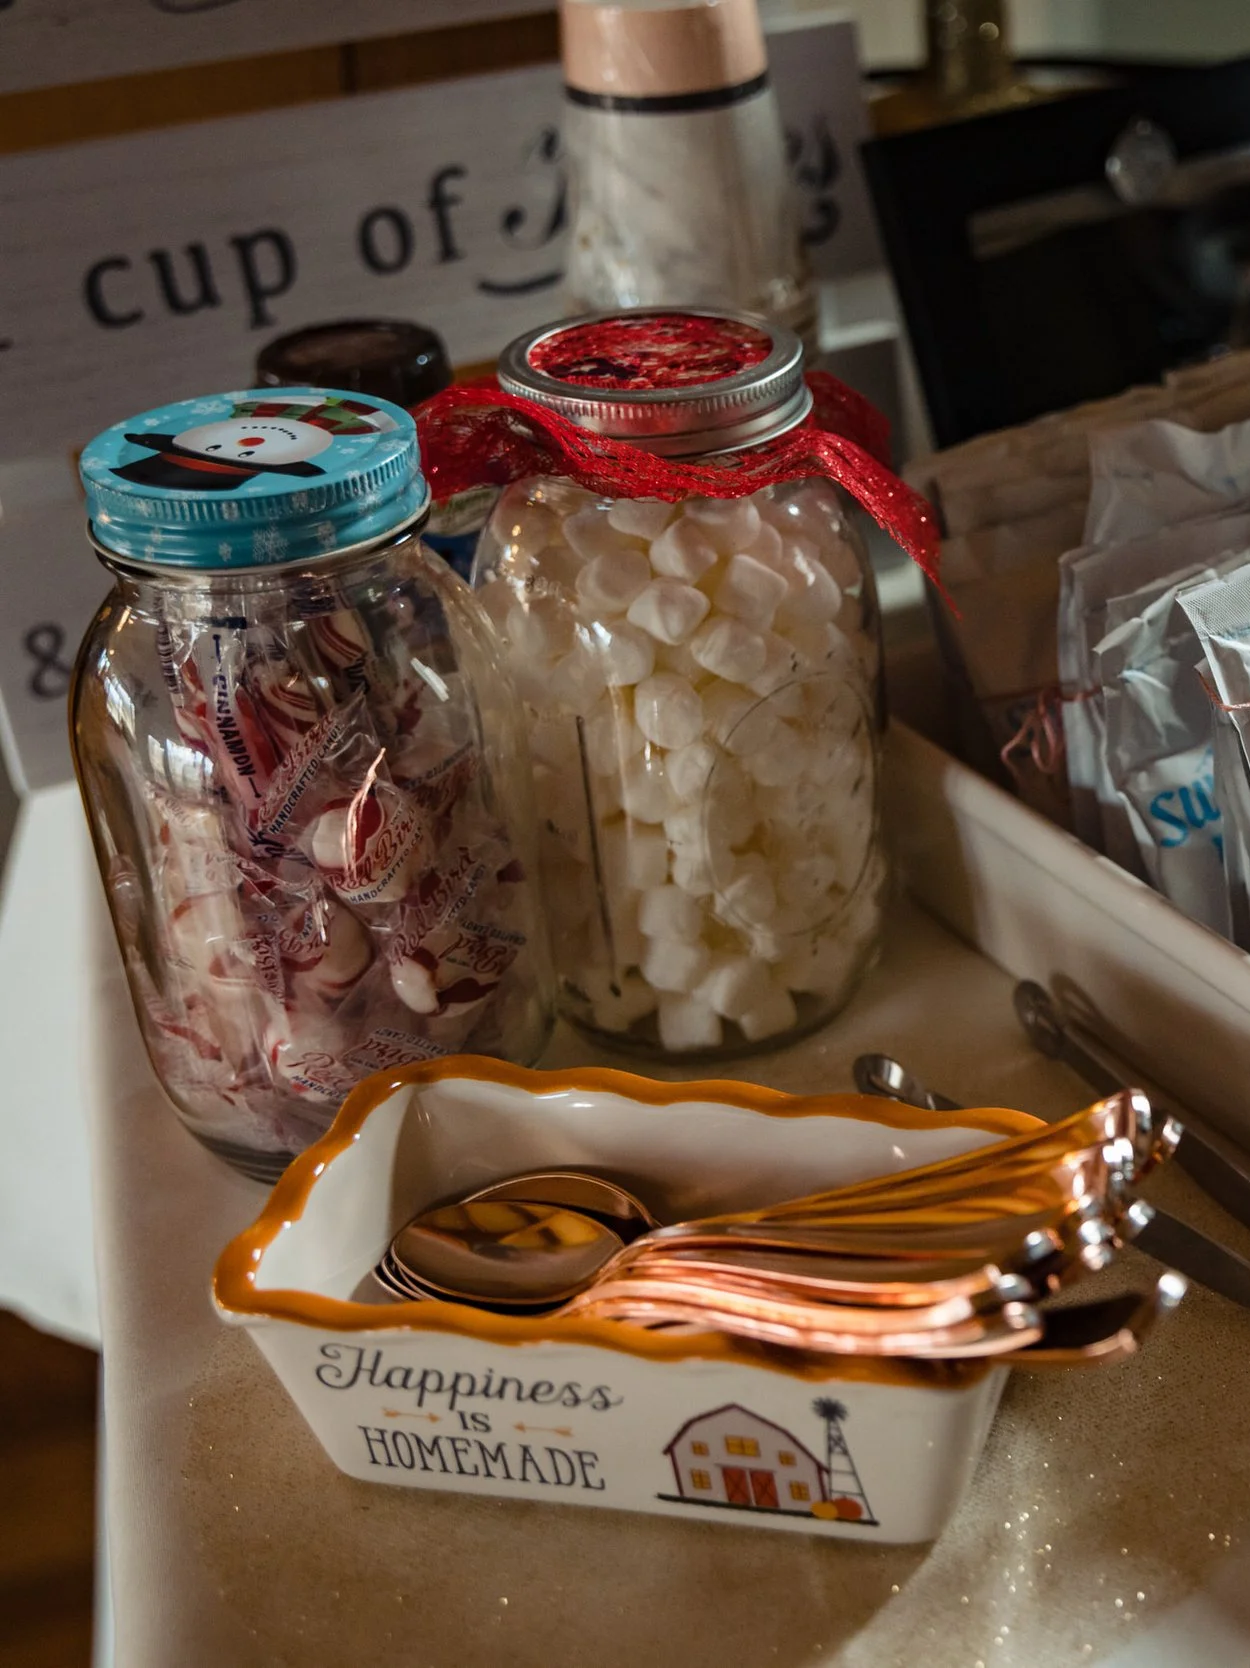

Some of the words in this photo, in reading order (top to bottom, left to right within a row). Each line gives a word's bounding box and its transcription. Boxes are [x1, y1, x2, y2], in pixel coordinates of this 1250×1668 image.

[82, 227, 297, 329] cup
[356, 163, 467, 276] of
[269, 759, 319, 835] HANDCRAFTED
[315, 1342, 624, 1411] Happiness
[457, 1410, 492, 1433] IS
[358, 1425, 606, 1491] HOMEMADE
